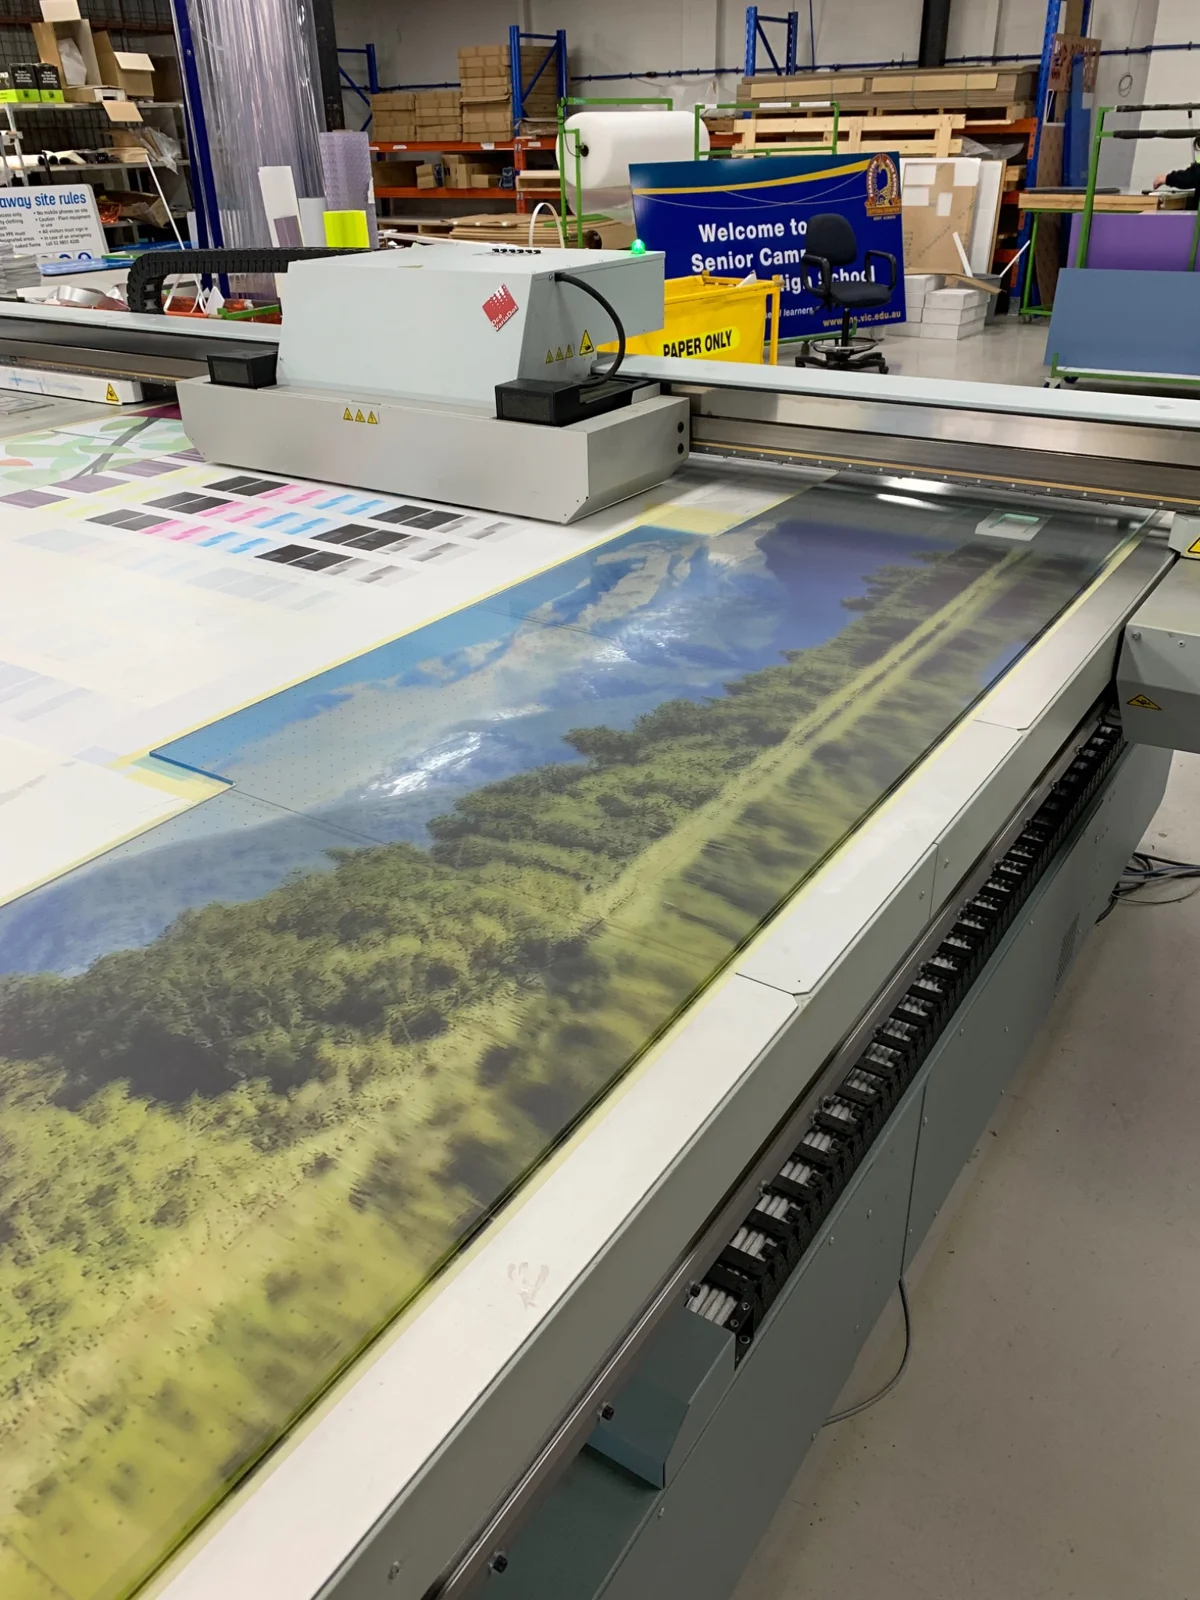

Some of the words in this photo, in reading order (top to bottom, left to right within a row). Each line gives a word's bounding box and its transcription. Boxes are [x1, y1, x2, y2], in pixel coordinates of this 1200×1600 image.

[34, 192, 56, 206] site
[59, 191, 87, 205] rules
[697, 221, 785, 244] Welcome
[789, 217, 808, 236] to
[691, 250, 754, 273] Senior
[663, 337, 702, 358] PAPER
[704, 329, 733, 352] ONLY
